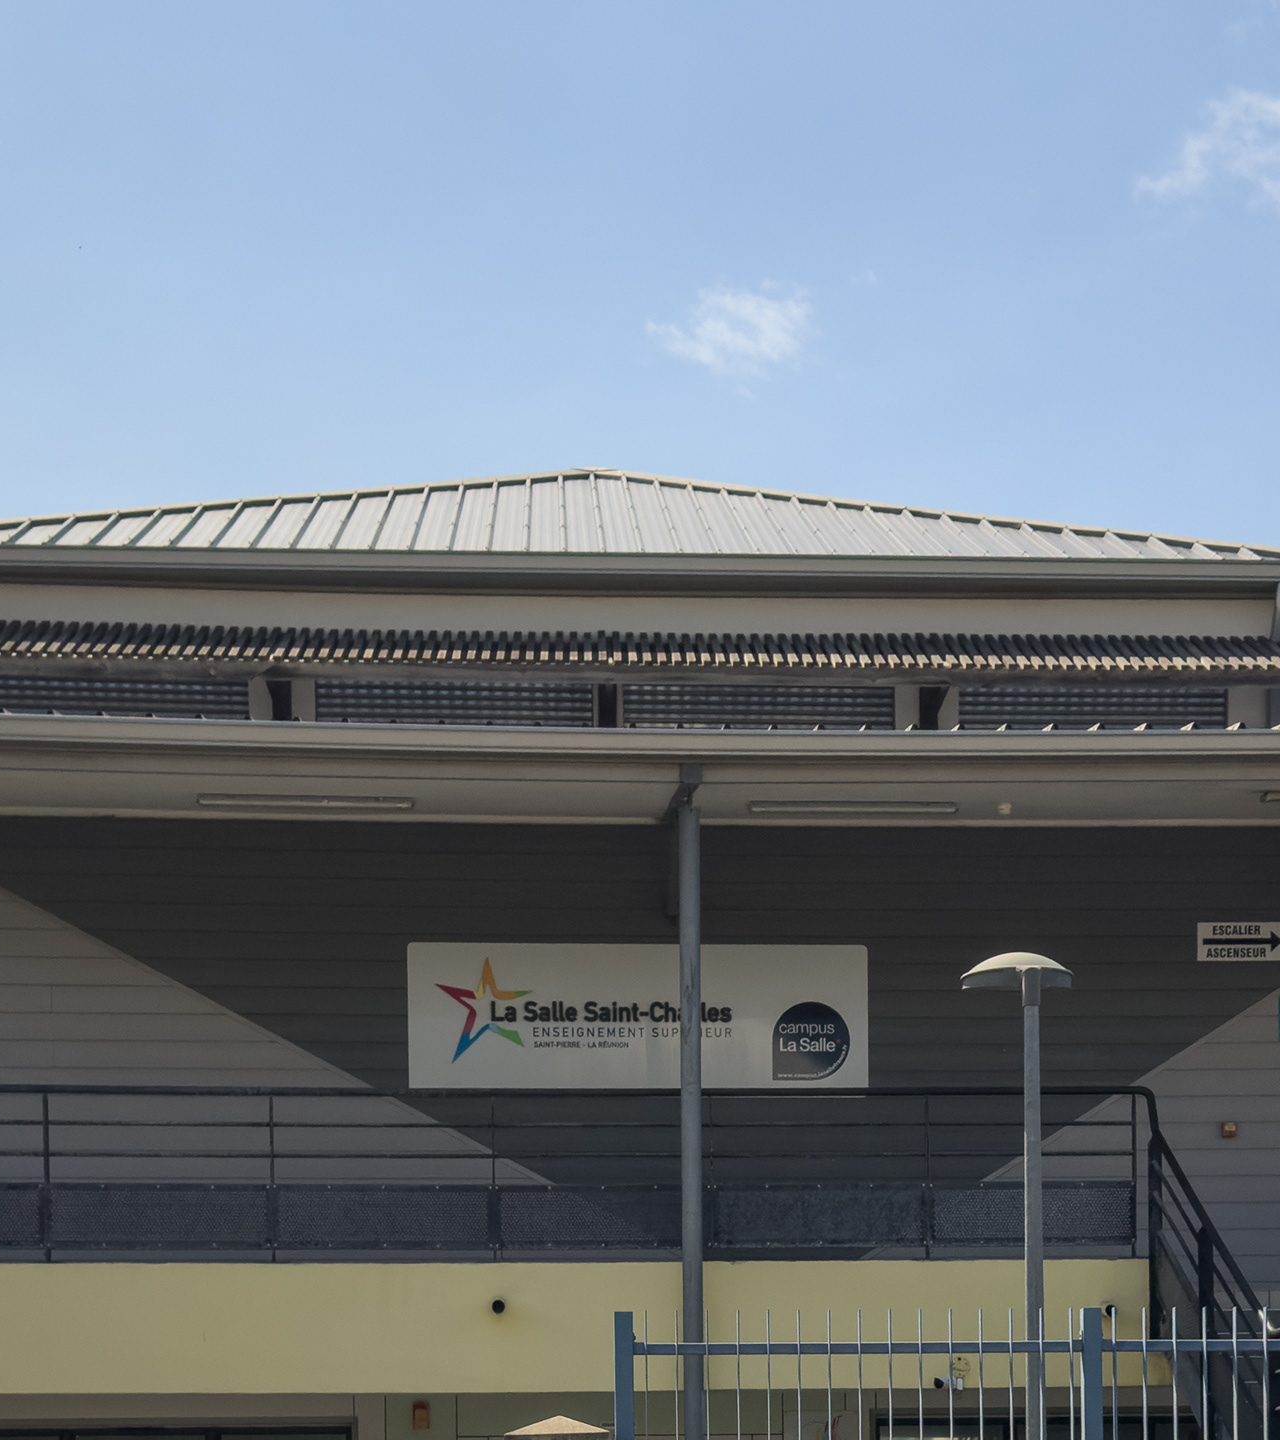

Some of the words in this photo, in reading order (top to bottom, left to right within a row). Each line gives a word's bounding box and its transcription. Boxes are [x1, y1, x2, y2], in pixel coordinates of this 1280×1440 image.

[1212, 925, 1261, 936] ESCALIER
[1206, 947, 1267, 958] ASCENSEUR
[490, 1001, 517, 1023] La
[523, 1001, 578, 1023] Salle
[583, 1001, 733, 1024] Saint-Chles
[532, 1026, 645, 1038] ENSEIGNEMENT
[651, 1027, 733, 1038] SUPEUR
[778, 1022, 835, 1035] campus
[533, 1041, 581, 1049] SAINT-PIERRE
[598, 1040, 629, 1049] RÉUNION
[779, 1037, 797, 1052] La
[799, 1037, 836, 1052] Salle
